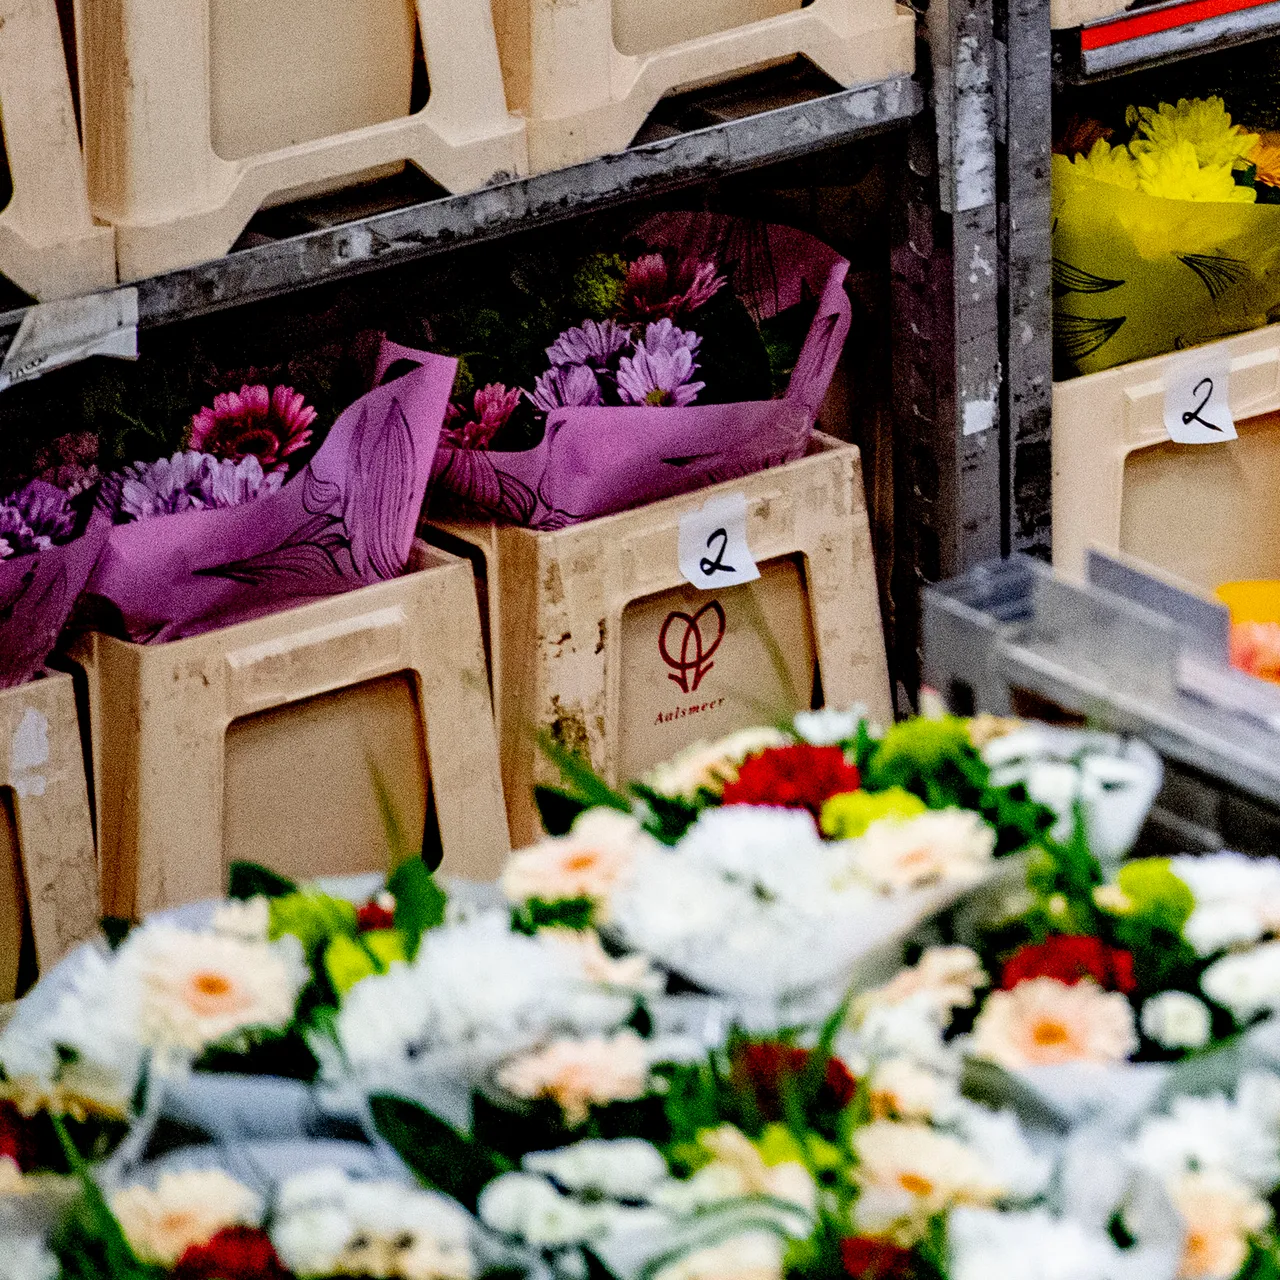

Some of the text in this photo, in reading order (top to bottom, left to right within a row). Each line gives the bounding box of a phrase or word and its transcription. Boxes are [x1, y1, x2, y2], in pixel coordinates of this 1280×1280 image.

[1182, 377, 1225, 433] 2
[700, 527, 737, 576] 2
[654, 696, 726, 726] Aalsmeer
